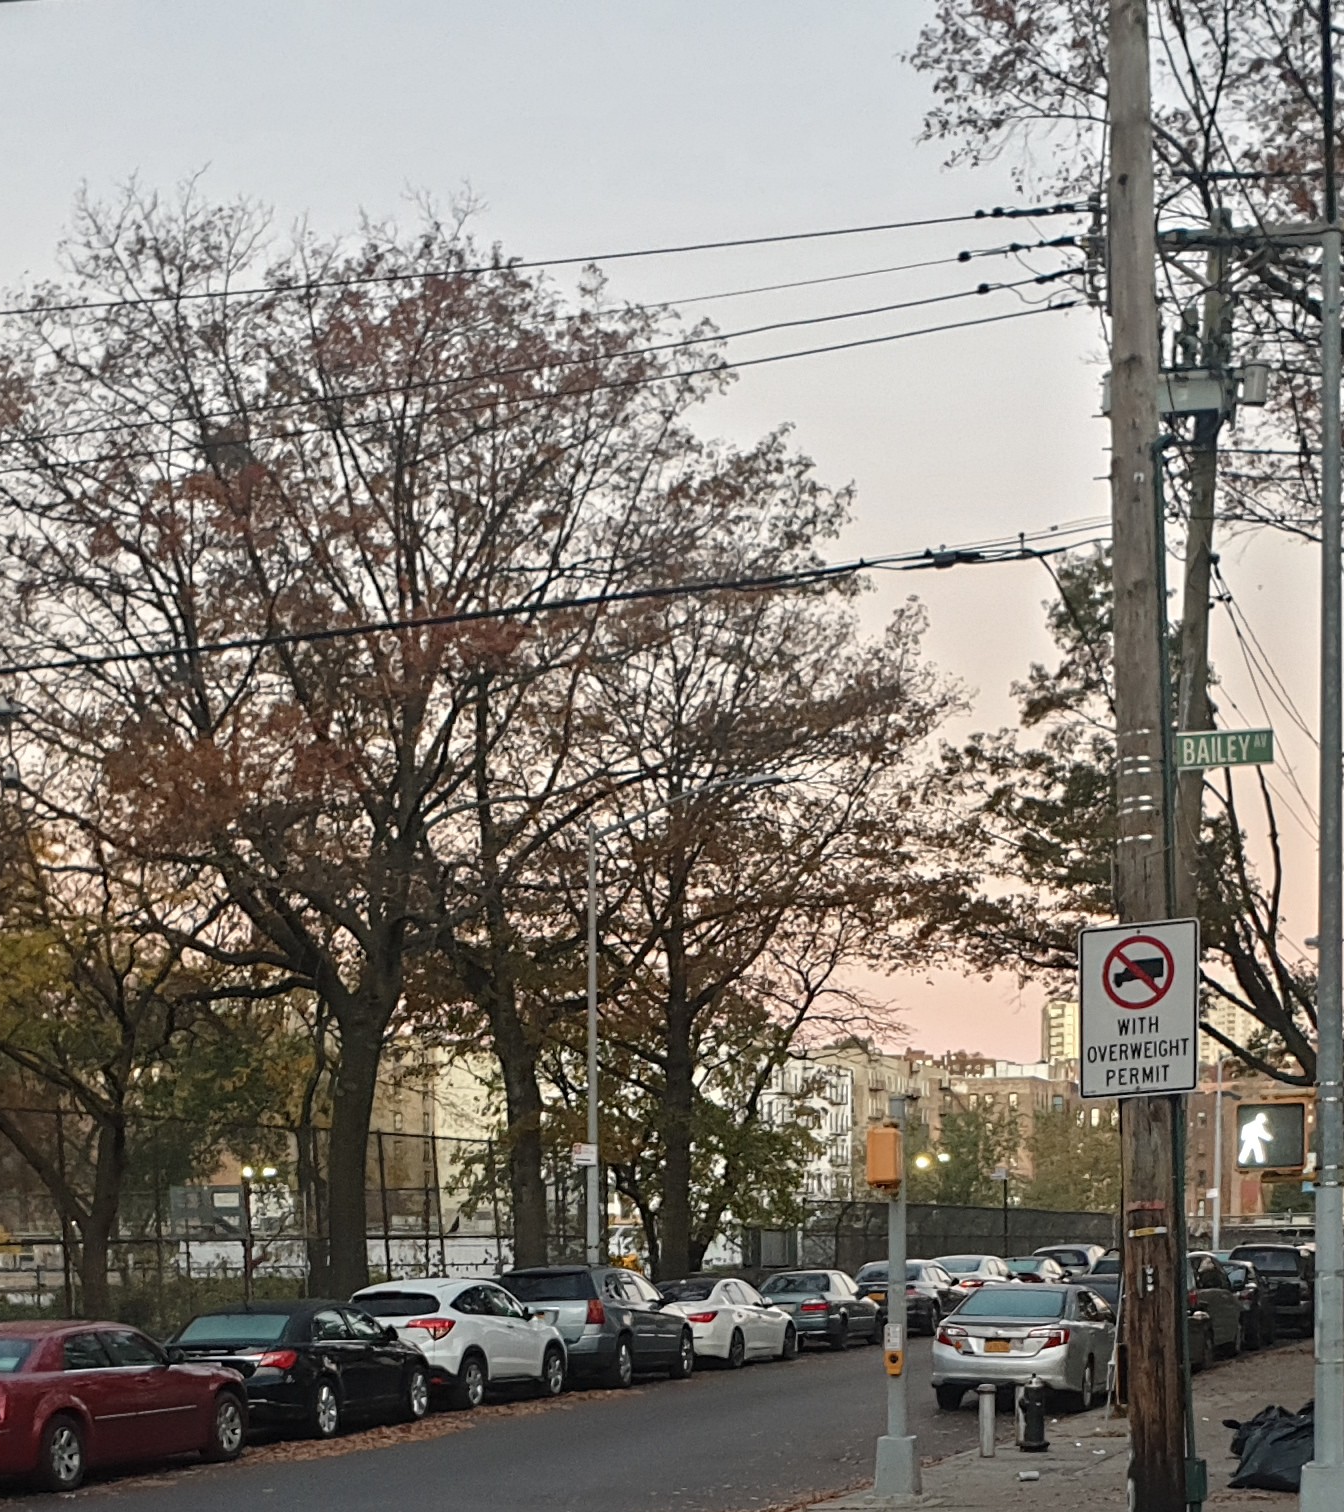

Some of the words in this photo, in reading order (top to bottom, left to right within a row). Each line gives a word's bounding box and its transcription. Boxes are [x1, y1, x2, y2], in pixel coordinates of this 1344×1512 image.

[1183, 735, 1250, 765] BAILEY
[1254, 733, 1267, 748] AV
[1117, 1016, 1159, 1036] WITH
[1087, 1038, 1189, 1064] OVERWEIGHT
[1105, 1065, 1170, 1087] PERMIT
